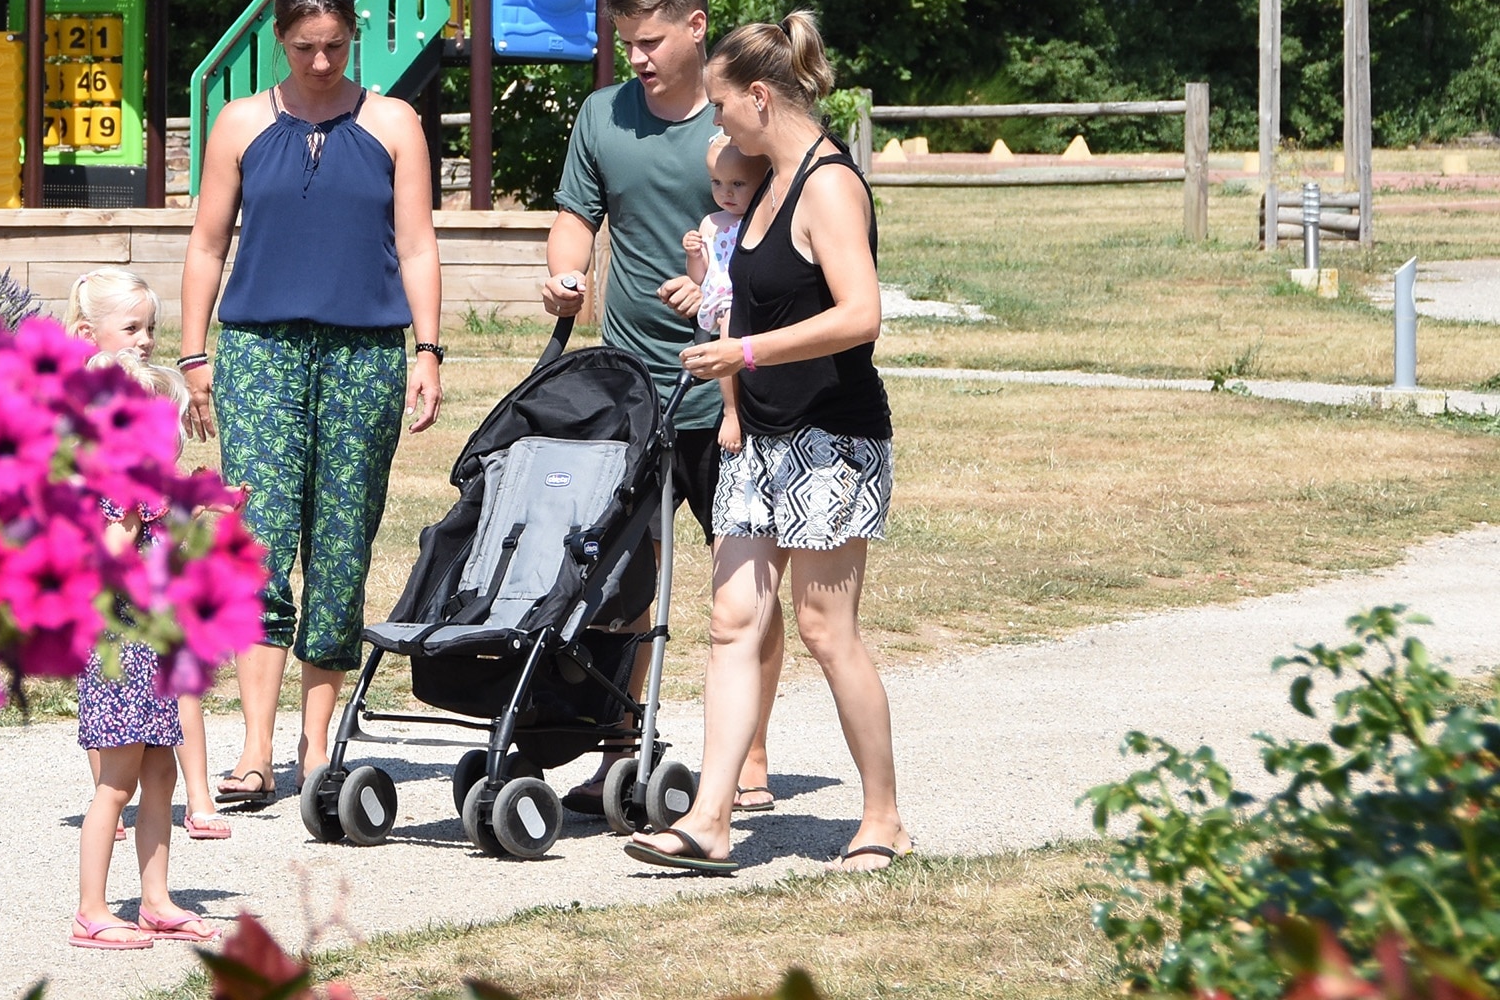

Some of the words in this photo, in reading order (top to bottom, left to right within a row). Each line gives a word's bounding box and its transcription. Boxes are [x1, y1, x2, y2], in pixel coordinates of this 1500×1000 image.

[69, 26, 86, 49] 2
[96, 26, 107, 49] 1
[77, 71, 91, 93] 4
[92, 70, 107, 92] 6
[99, 116, 115, 138] 9
